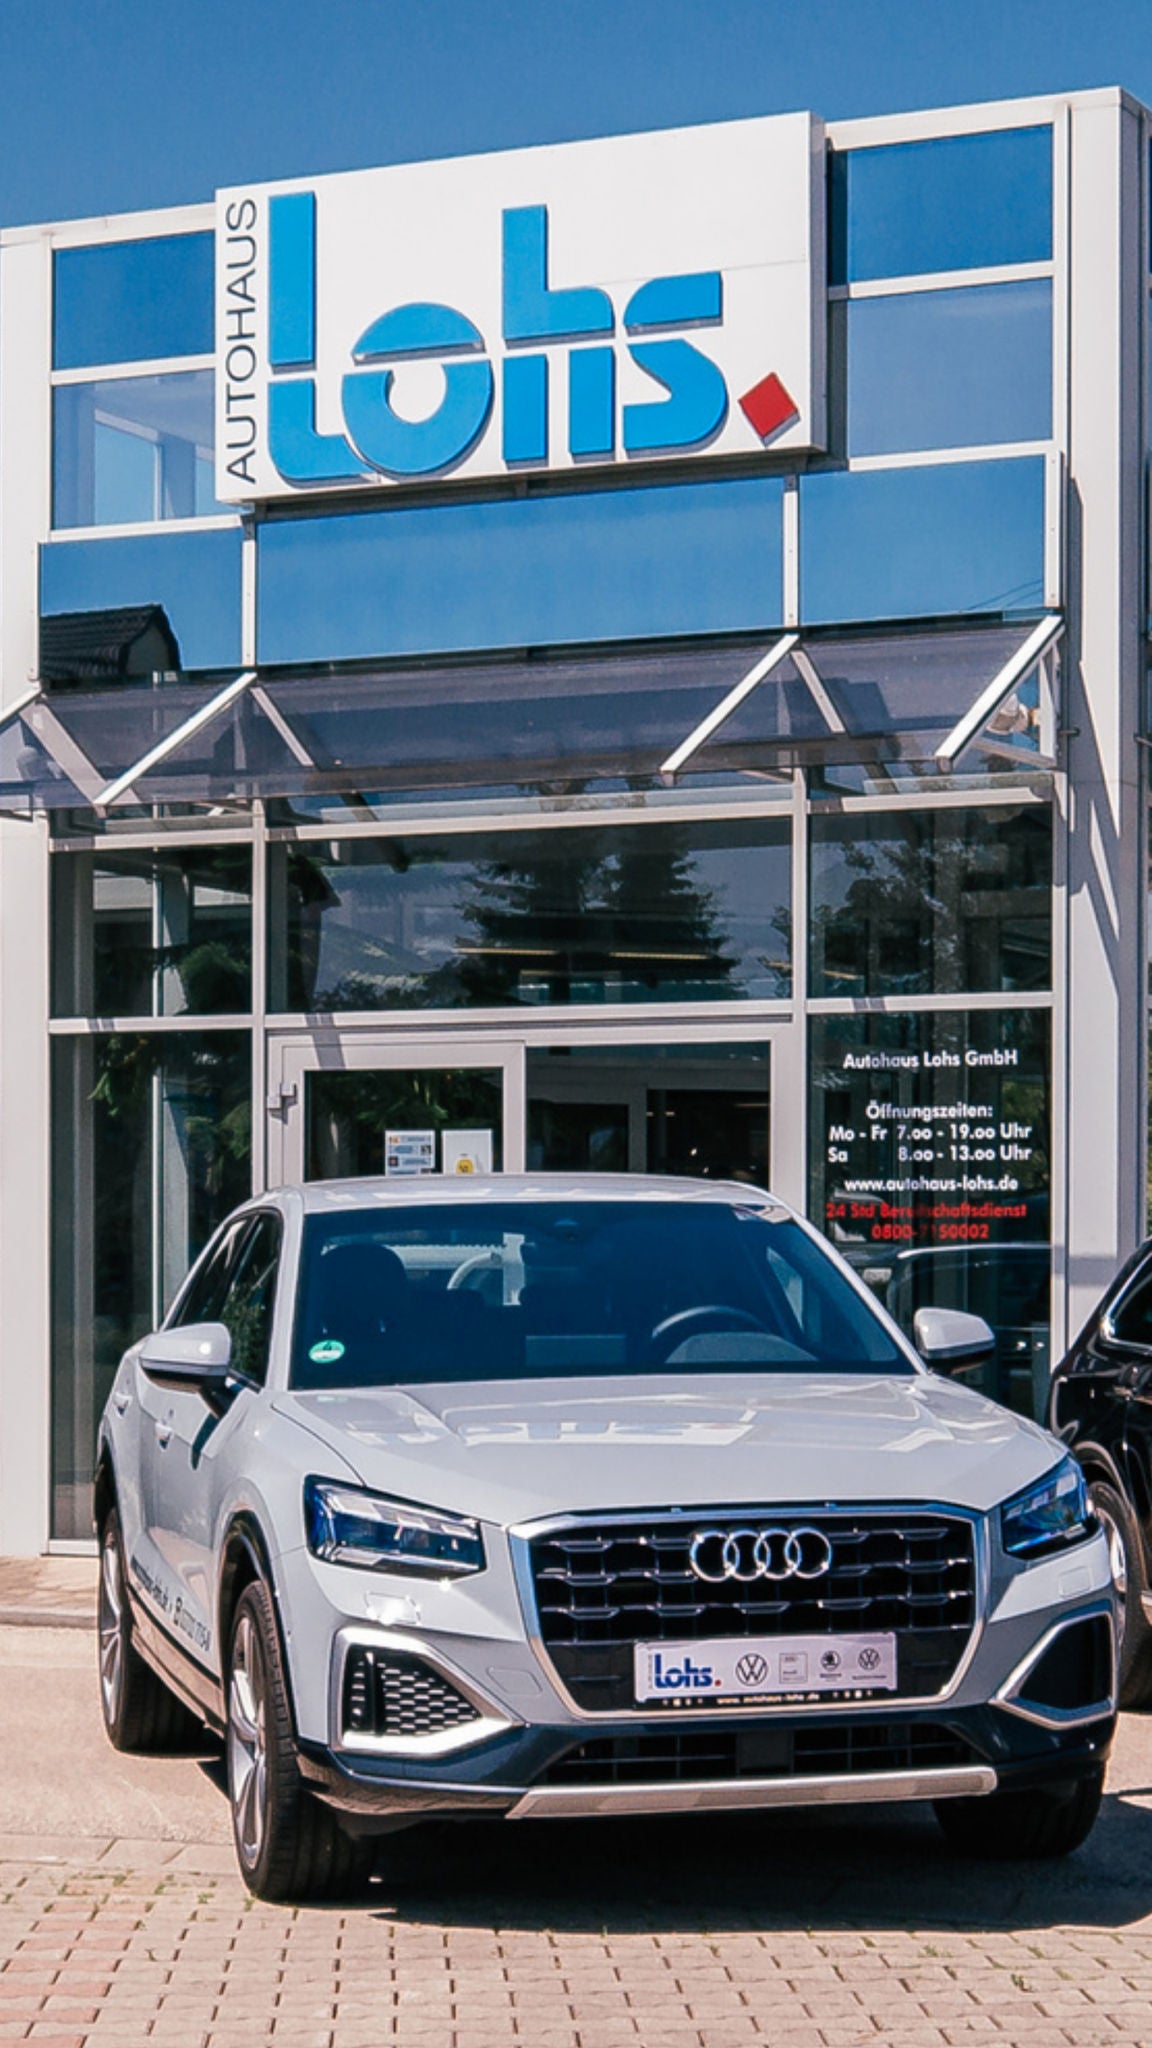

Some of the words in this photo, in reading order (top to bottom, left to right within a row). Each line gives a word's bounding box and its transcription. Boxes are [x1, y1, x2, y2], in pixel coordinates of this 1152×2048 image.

[225, 199, 257, 485] AUTOHAUS
[843, 1053, 919, 1069] Autohaus
[924, 1051, 960, 1067] Lohs
[965, 1049, 1018, 1066] GmbH
[866, 1100, 993, 1123] Öffnungszeiten:
[829, 1126, 854, 1141] Mo
[871, 1125, 887, 1140] Fr
[1000, 1123, 1032, 1138] Uhr
[828, 1147, 848, 1162] Sa
[1000, 1144, 1032, 1160] Uhr
[844, 1174, 1019, 1191] www.autohaus-lohs.de
[826, 1203, 846, 1218] 24
[850, 1203, 876, 1218] Std
[880, 1202, 1027, 1218] Berechaftsdienst
